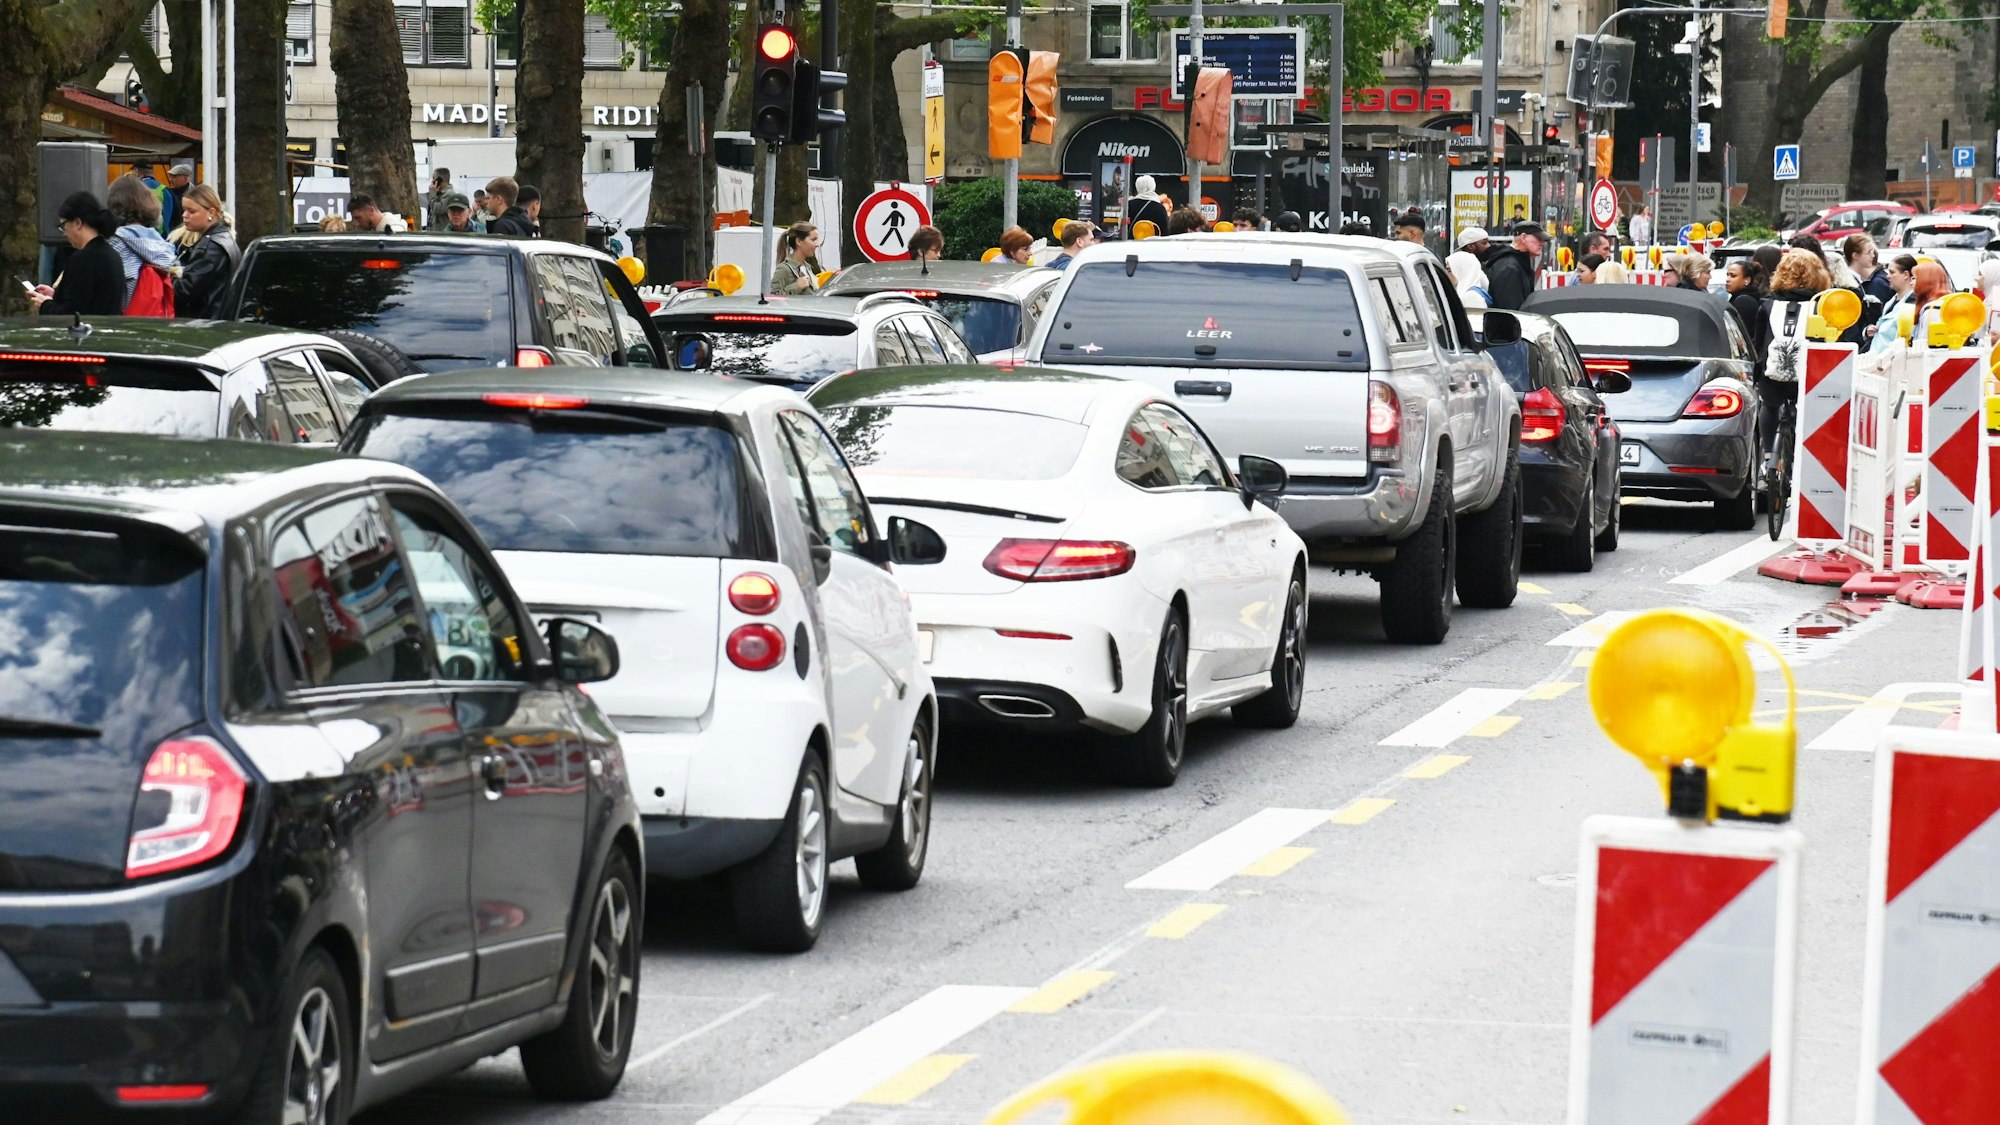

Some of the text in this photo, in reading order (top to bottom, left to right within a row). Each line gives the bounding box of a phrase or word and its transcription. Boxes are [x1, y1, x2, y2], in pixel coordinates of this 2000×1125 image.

[1066, 94, 1105, 102] Fotoservice
[1496, 96, 1510, 105] ntal
[422, 103, 660, 126] MADE RIDI
[1097, 141, 1151, 158] Nikon
[1957, 149, 1970, 165] P
[1341, 161, 1375, 174] calable
[1186, 329, 1233, 339] LEER
